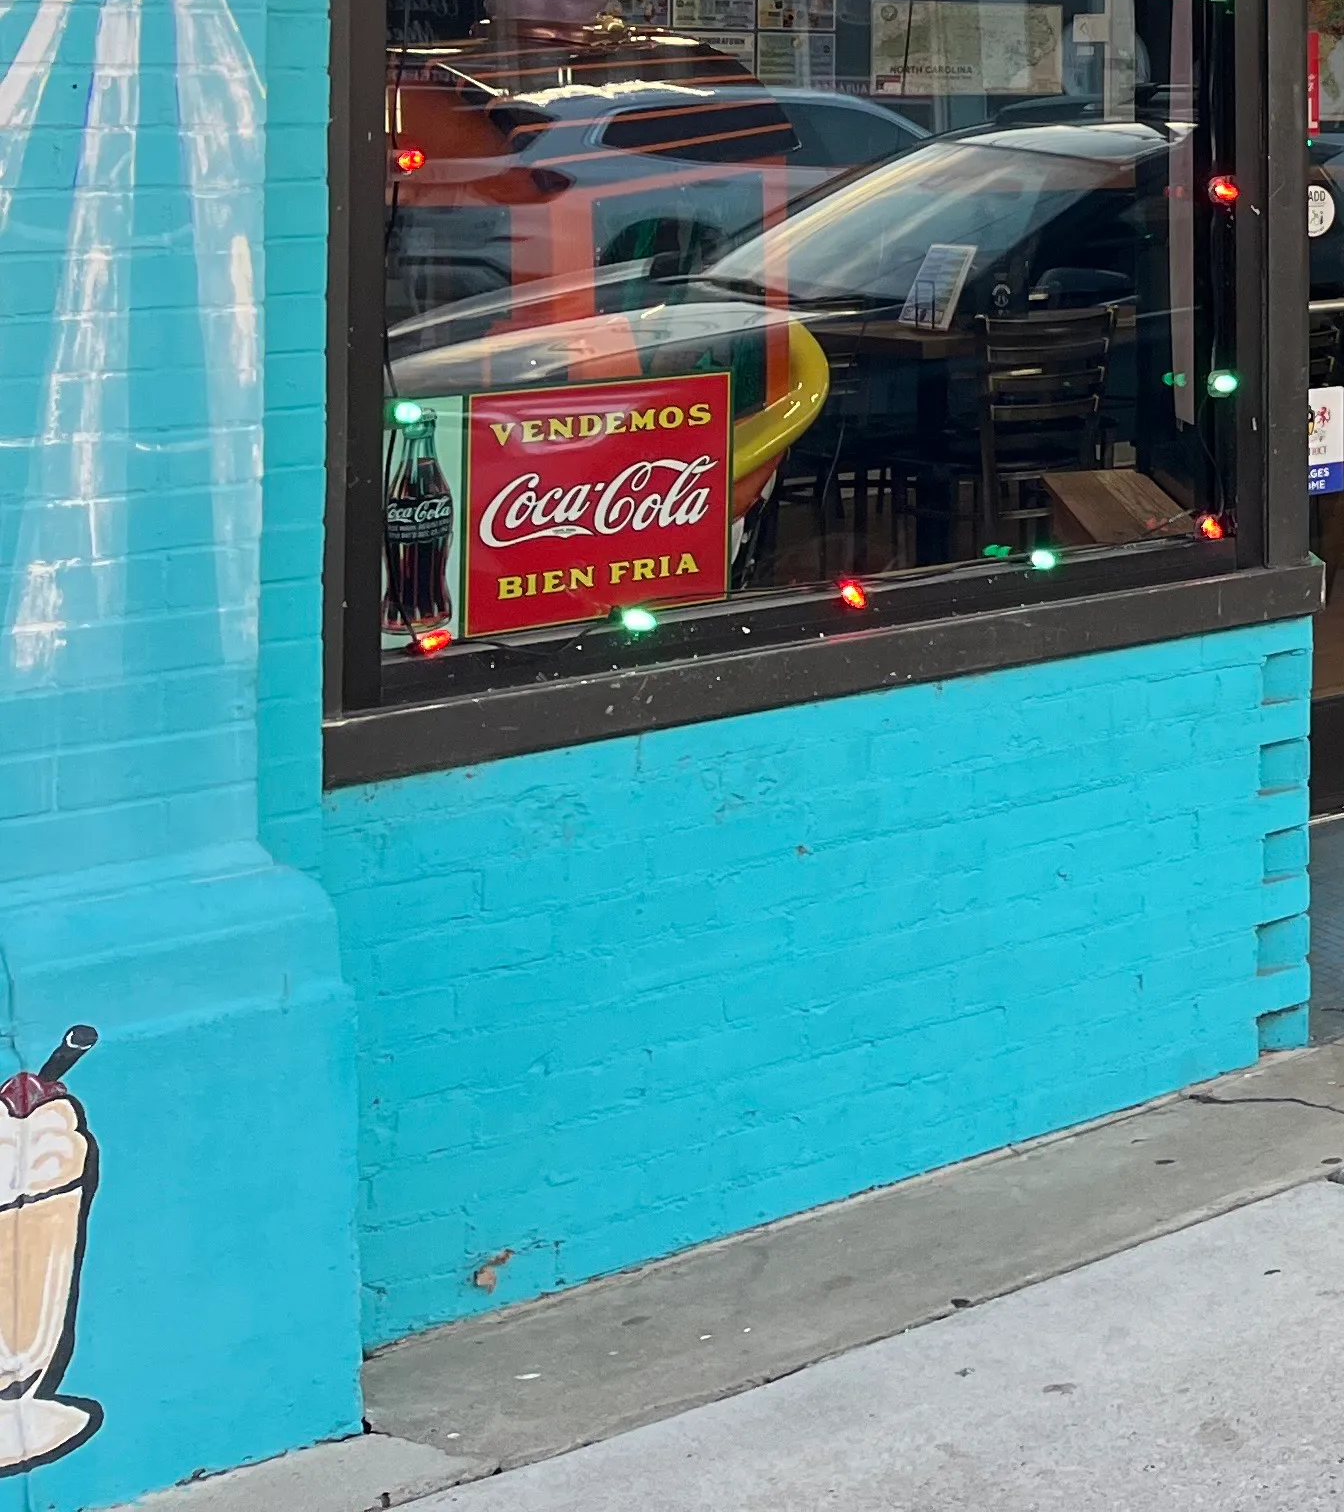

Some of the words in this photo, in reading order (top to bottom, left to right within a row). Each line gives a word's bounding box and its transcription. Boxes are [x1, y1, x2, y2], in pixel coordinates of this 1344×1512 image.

[890, 65, 923, 74] NORTH
[925, 65, 973, 74] CAROLINA
[490, 404, 712, 446] VENDEMOS
[479, 455, 719, 548] Coca-Cola
[498, 566, 594, 599] BIEN
[609, 553, 699, 584] FRIA
